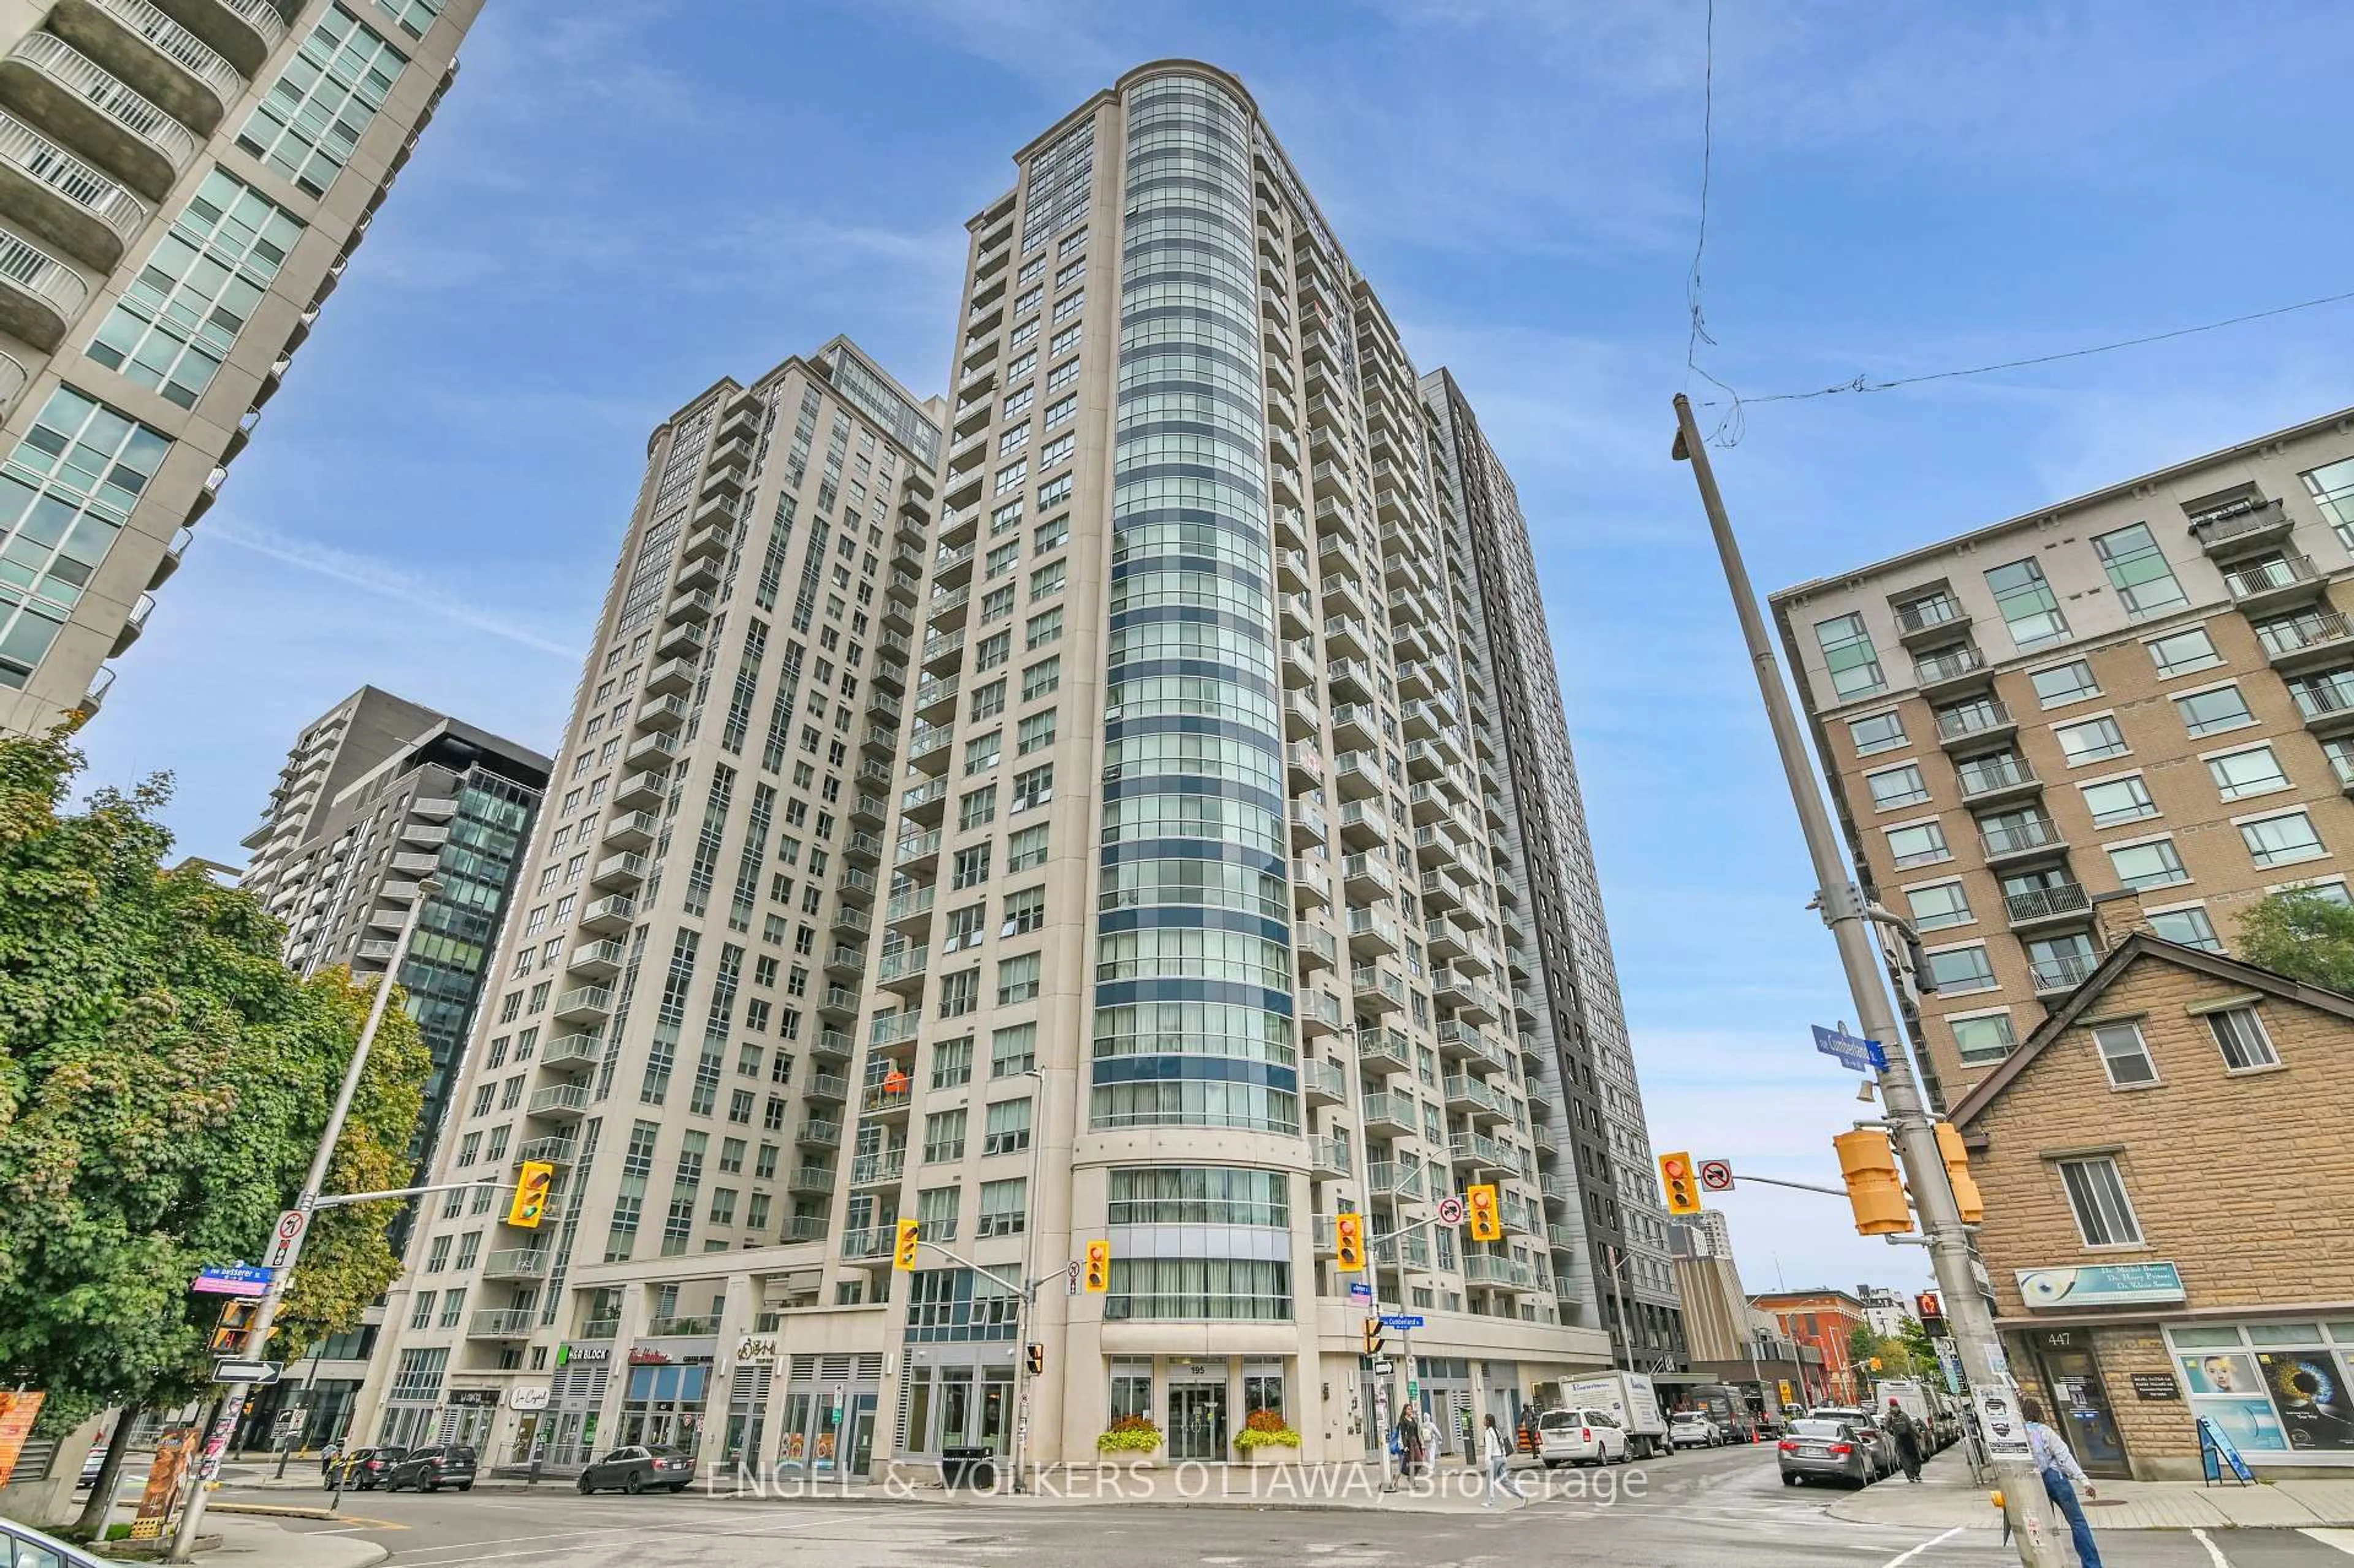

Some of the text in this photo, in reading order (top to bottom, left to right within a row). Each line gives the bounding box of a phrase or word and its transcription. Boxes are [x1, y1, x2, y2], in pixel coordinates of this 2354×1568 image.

[2049, 1333, 2070, 1345] 447
[583, 1349, 607, 1360] BLOCK
[1191, 1365, 1205, 1374] 195
